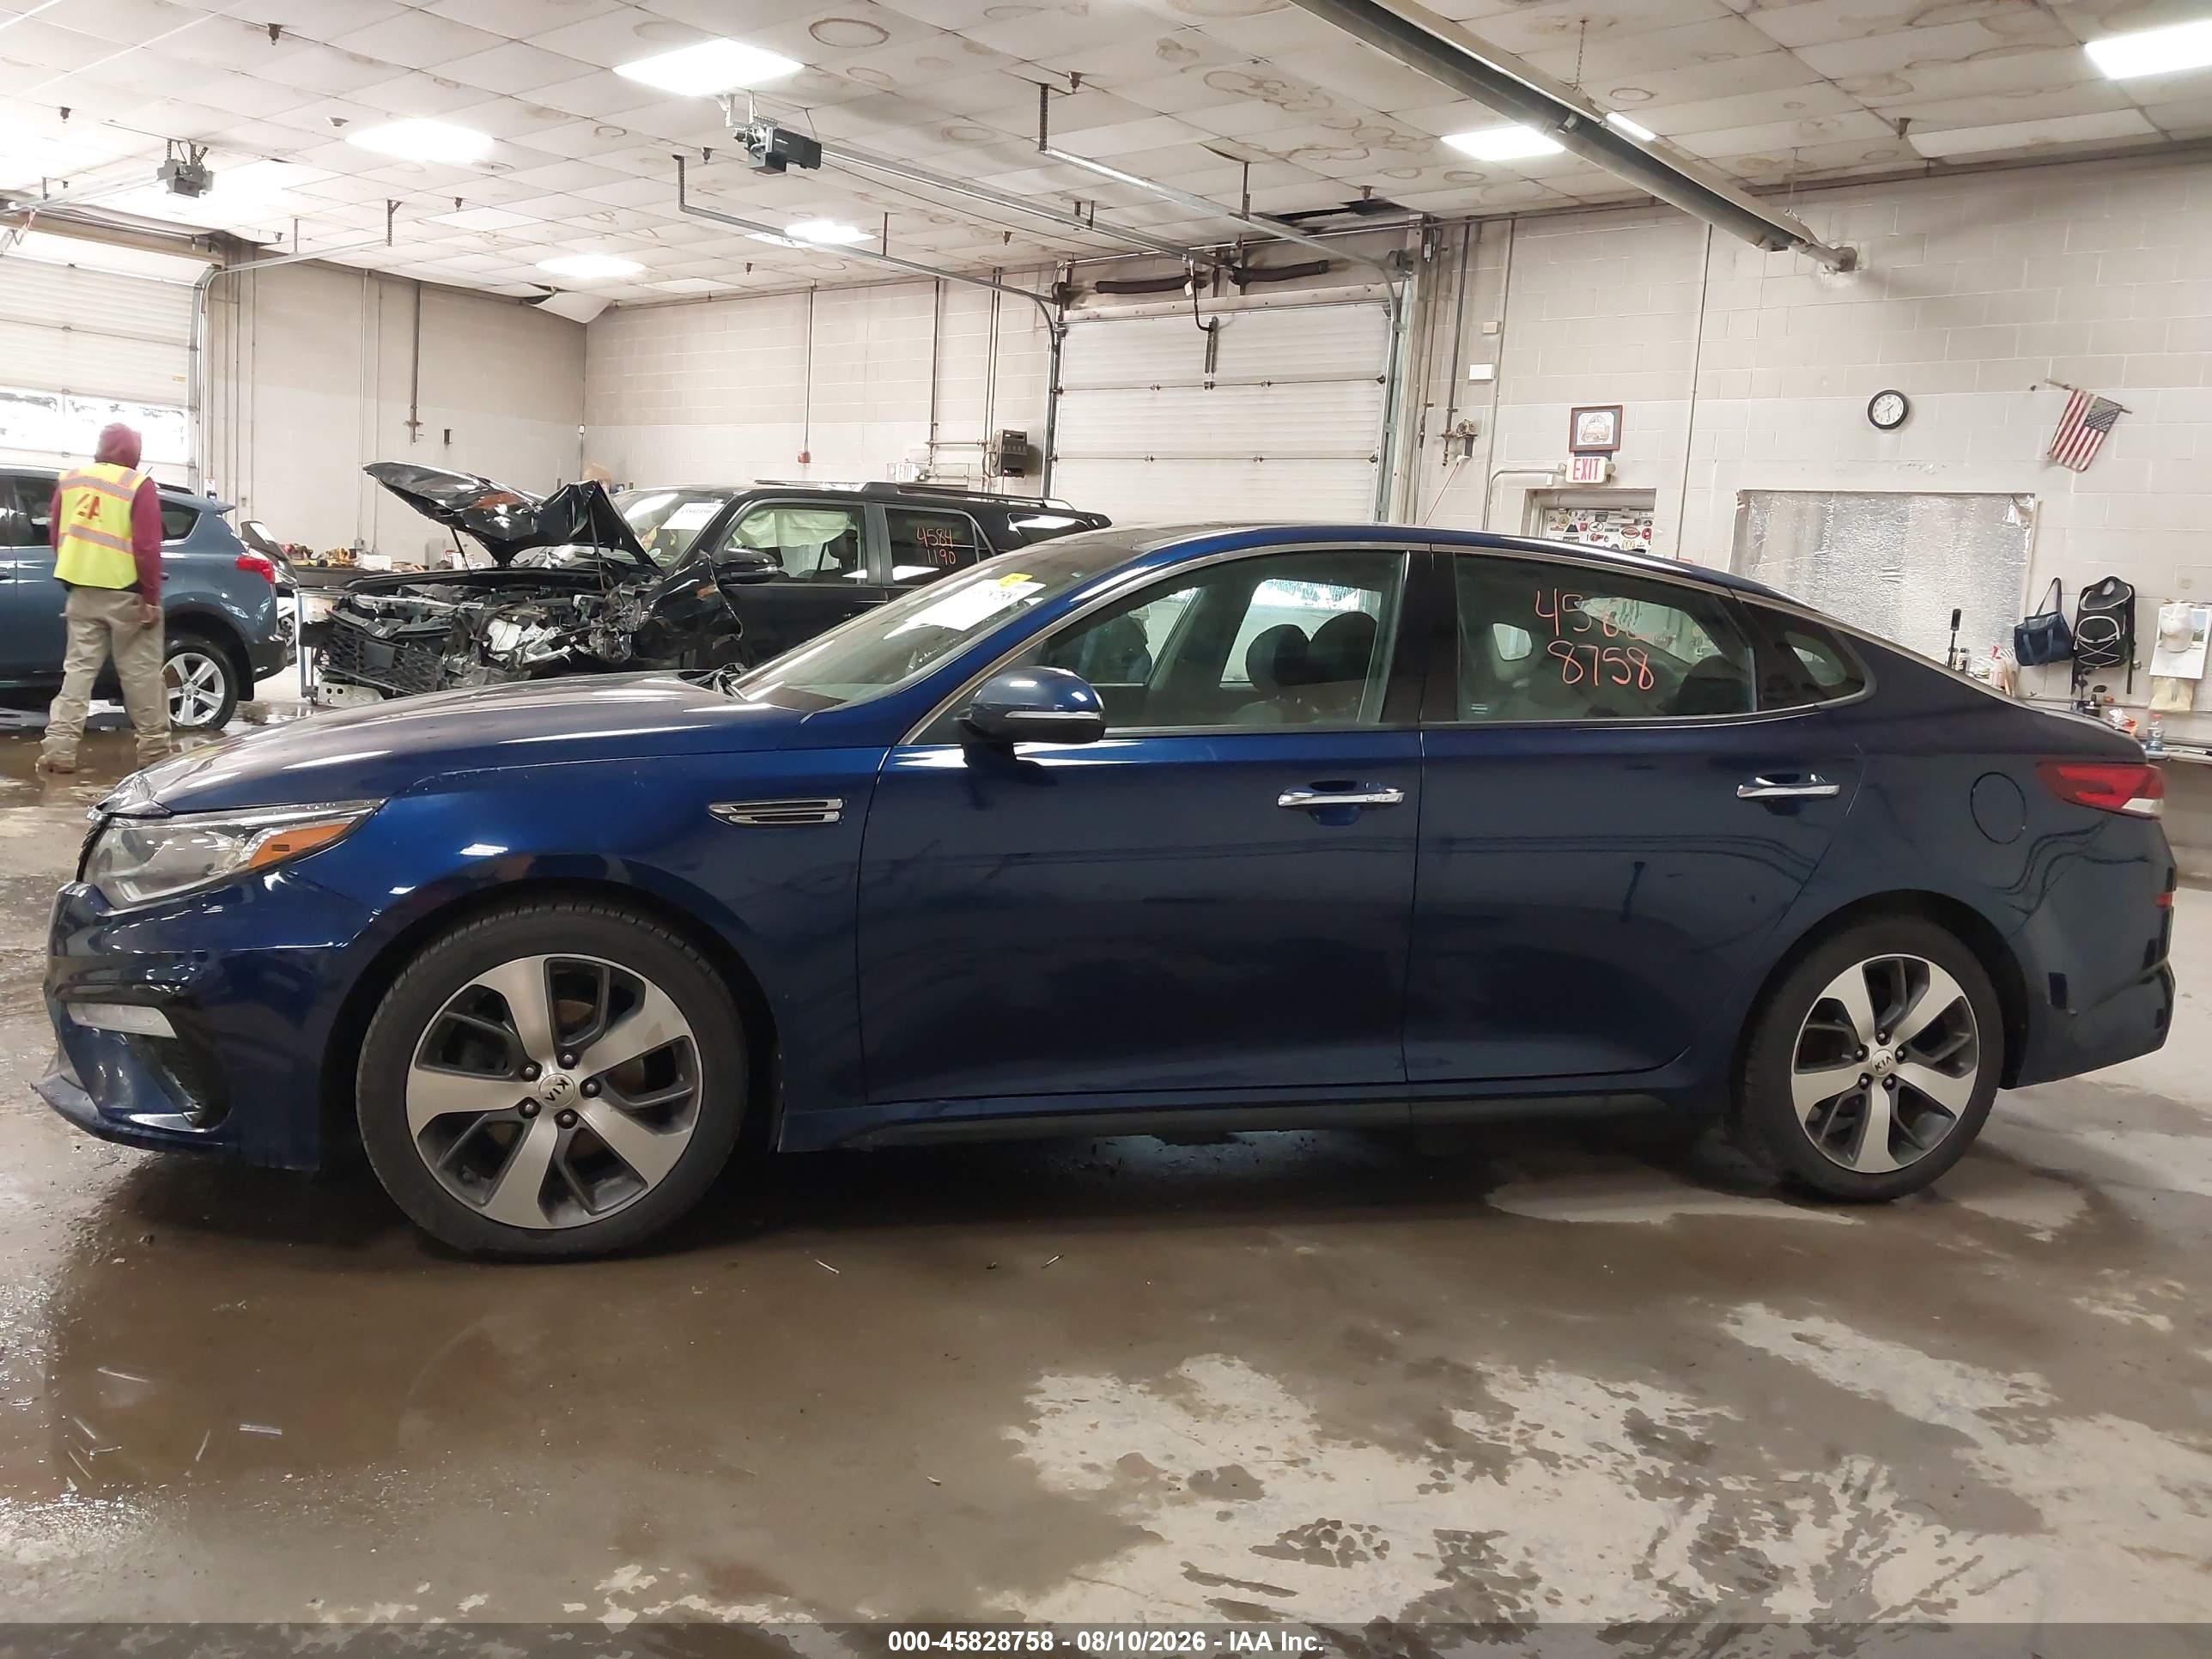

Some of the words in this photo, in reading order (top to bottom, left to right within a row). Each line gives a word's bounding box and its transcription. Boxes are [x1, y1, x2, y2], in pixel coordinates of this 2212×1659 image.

[1572, 458, 1601, 481] EXIT
[916, 526, 954, 549] 4584
[927, 549, 957, 566] 1190
[1547, 640, 1655, 690] 8758
[1875, 1055, 1893, 1072] KIA
[544, 1079, 569, 1102] KIA
